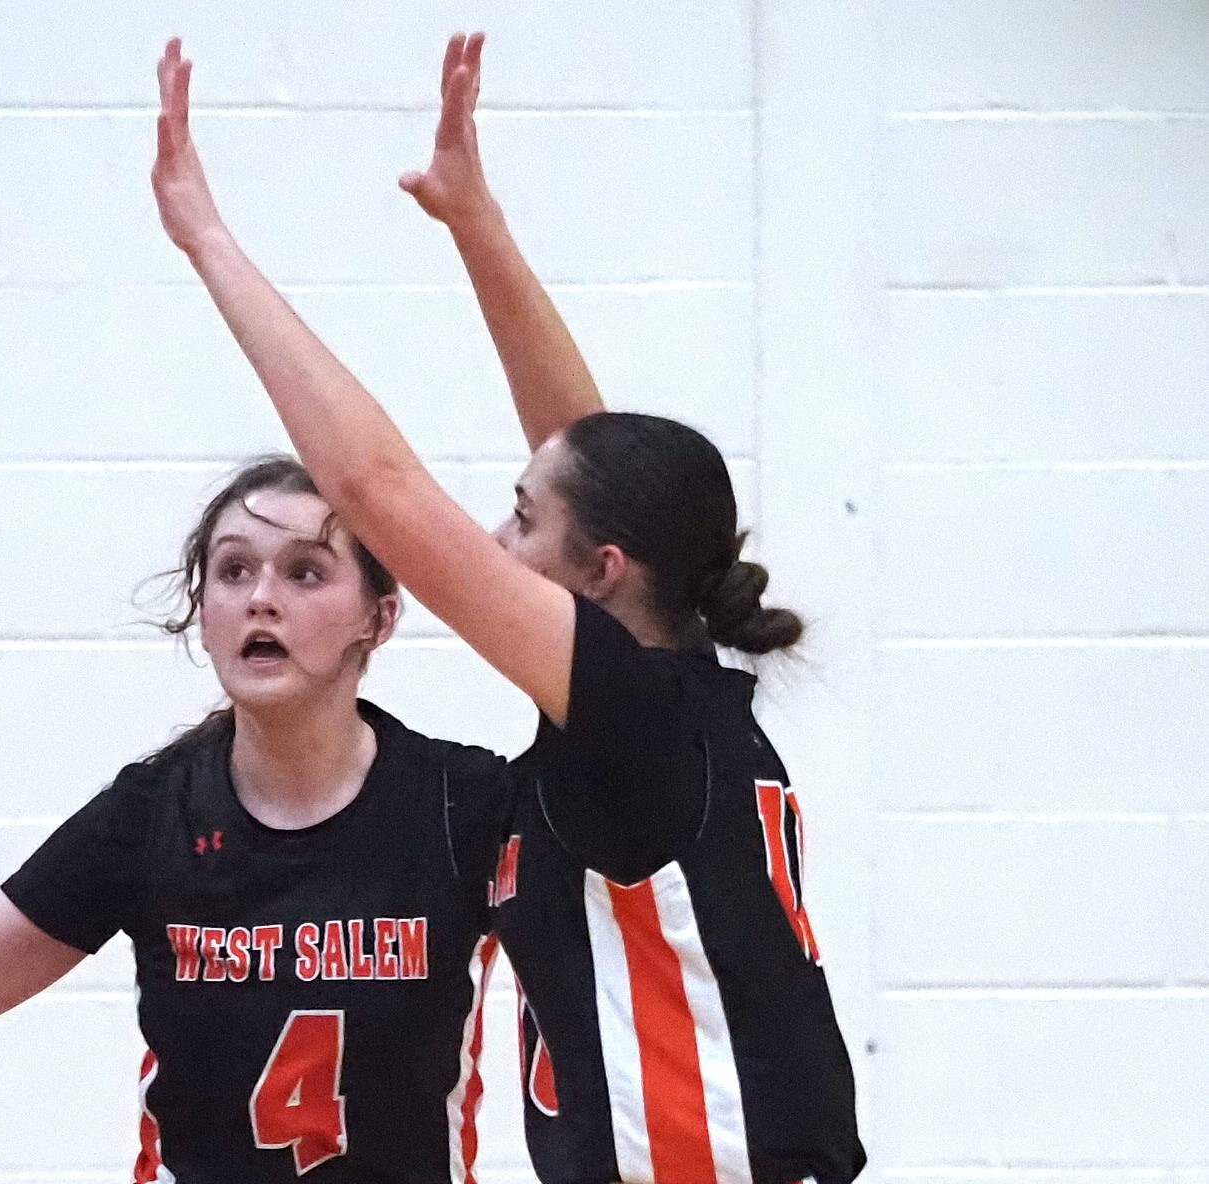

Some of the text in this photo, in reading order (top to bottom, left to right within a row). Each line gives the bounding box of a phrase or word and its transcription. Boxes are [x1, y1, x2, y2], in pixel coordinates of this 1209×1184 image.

[166, 916, 429, 982] WEST SALEM
[248, 1008, 348, 1177] 4
